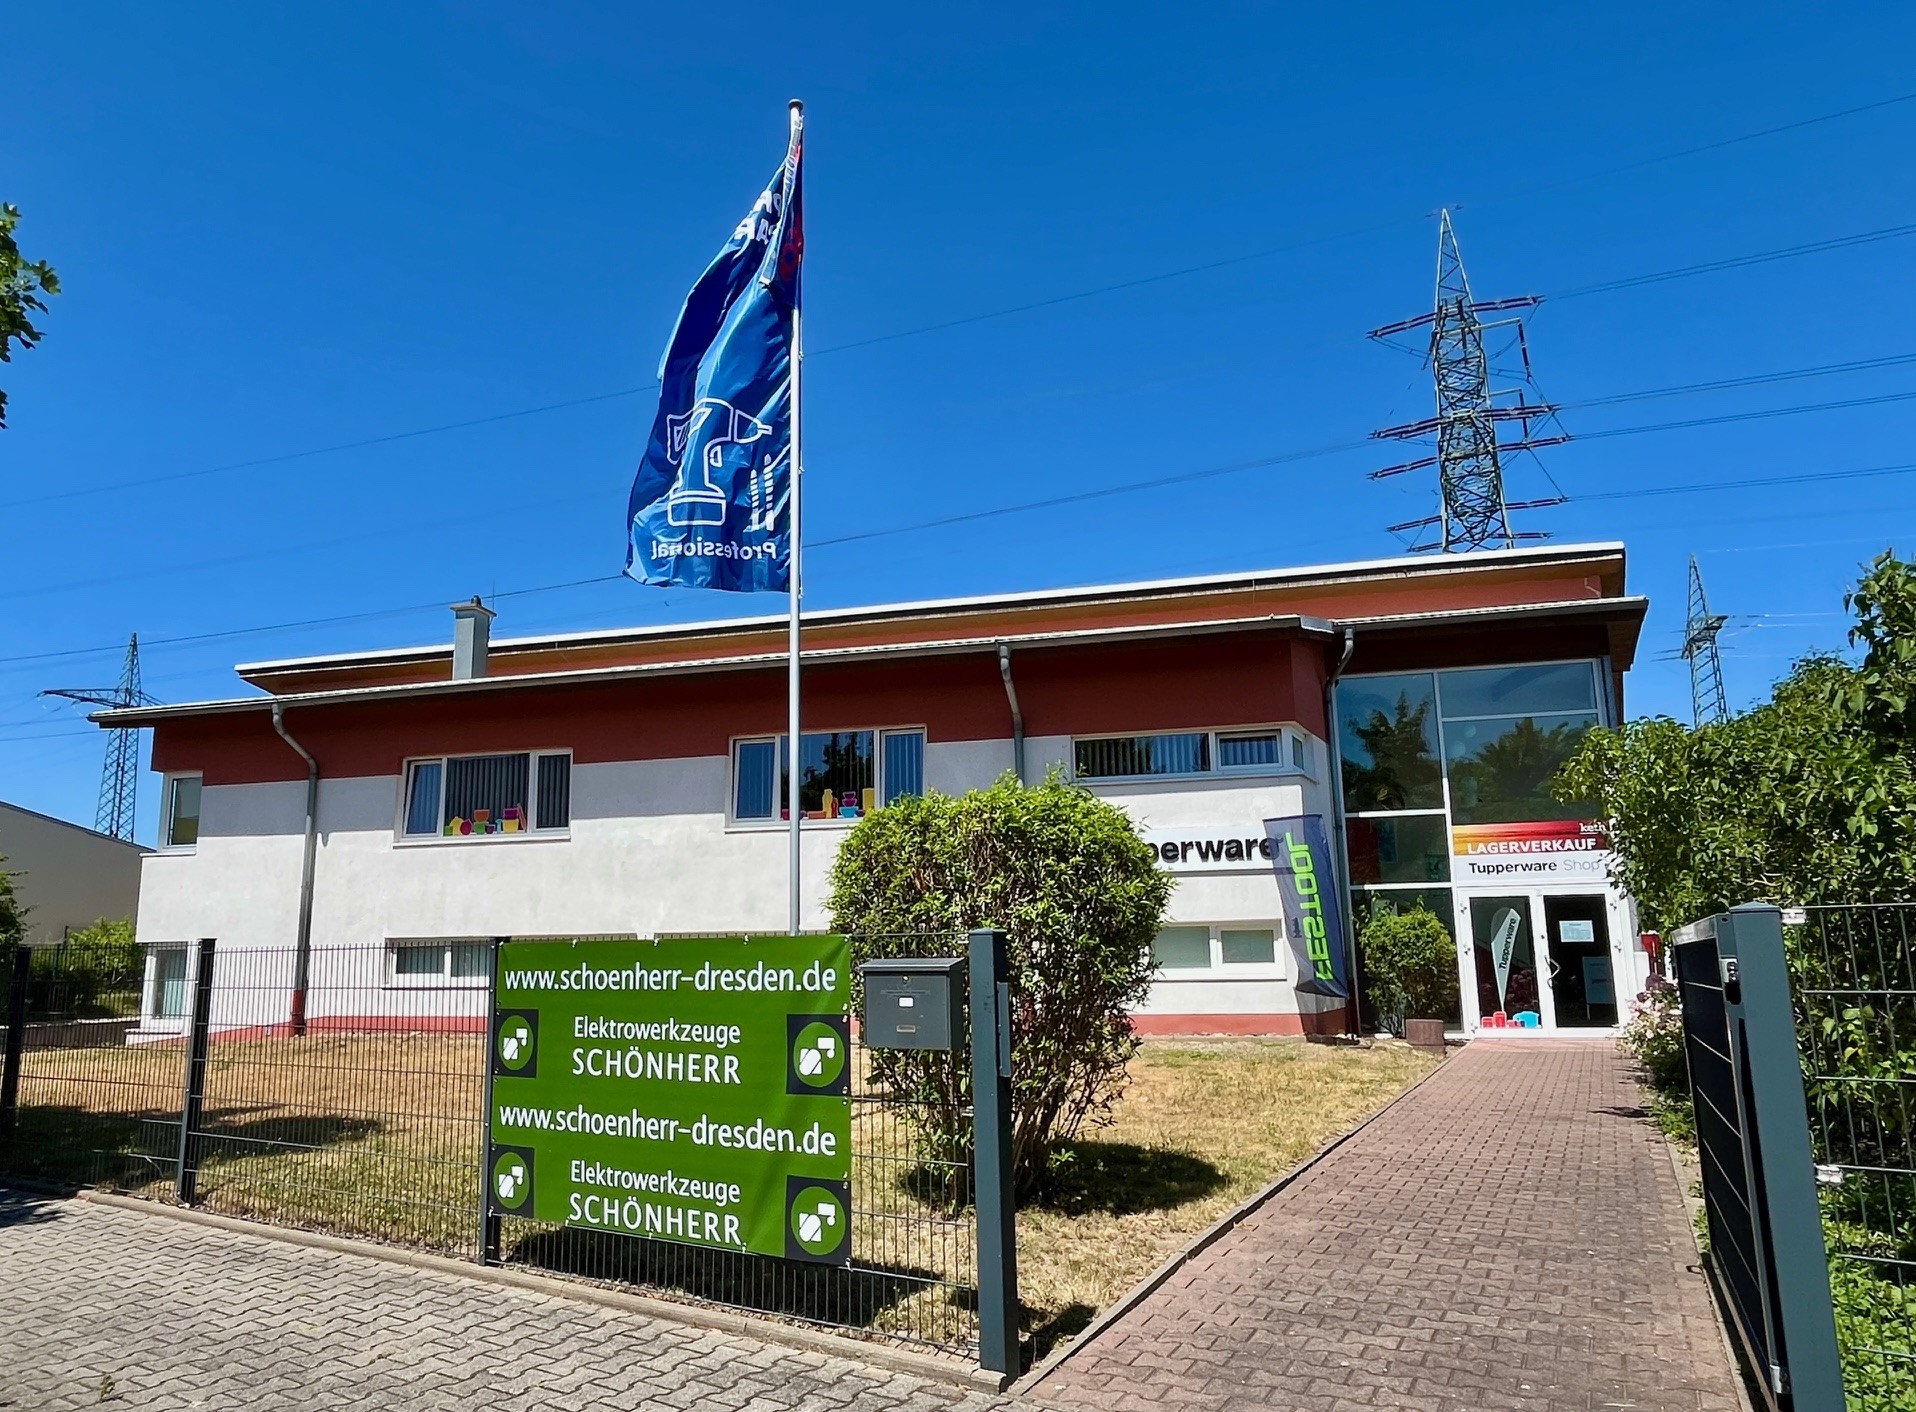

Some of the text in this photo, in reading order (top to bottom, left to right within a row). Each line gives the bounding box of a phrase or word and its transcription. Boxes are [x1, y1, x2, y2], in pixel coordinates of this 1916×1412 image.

[1467, 838, 1597, 854] LAGERVERKAUF
[1469, 859, 1600, 875] Tupperware Shop
[1499, 918, 1516, 969] Tupperware
[505, 960, 837, 992] www.schoenherr-dresden.de
[574, 1017, 741, 1049] Elektrowerkzeuge
[572, 1046, 742, 1085] SCHÖNHERR
[500, 1104, 837, 1157] www.schoenherr-dresden.de
[570, 1160, 741, 1206] Elektrowerkzeuge
[568, 1192, 742, 1245] SCHÖNHERR
